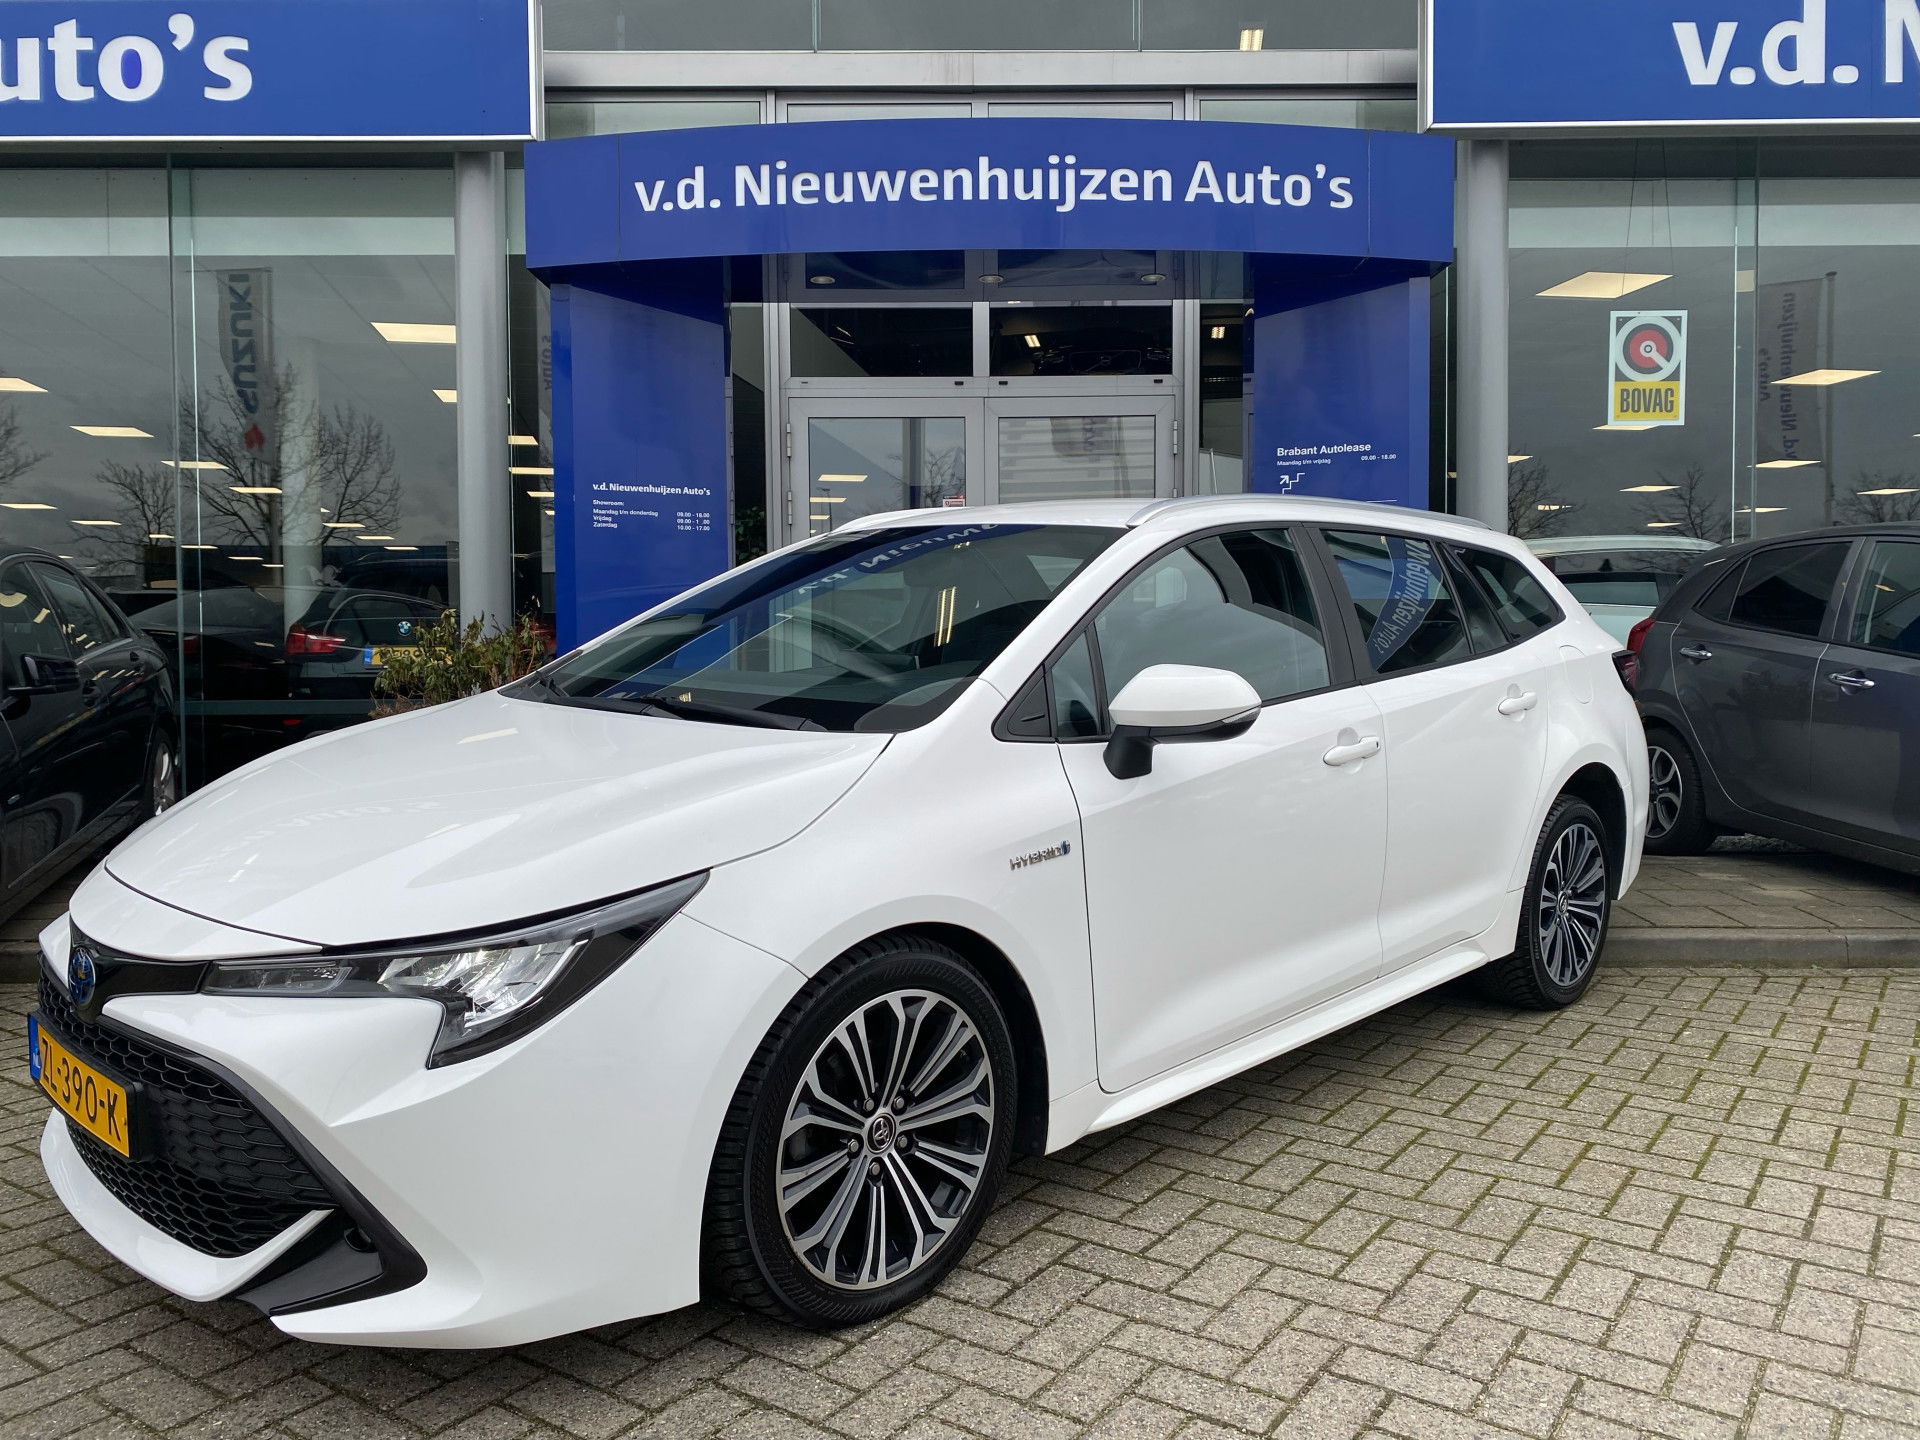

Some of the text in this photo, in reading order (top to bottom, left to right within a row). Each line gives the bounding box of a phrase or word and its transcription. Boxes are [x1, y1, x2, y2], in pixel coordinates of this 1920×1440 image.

[1672, 0, 1859, 85] v.d.
[634, 154, 1354, 213] v.d. Nieuwenhuijzen Auto's
[1620, 387, 1675, 413] BOVAG
[1277, 443, 1372, 457] Brabant Autolease
[592, 482, 711, 496] v.d. Nieuwenhuijzen Auto's
[593, 521, 618, 529] Zaterdag
[630, 509, 658, 517] donderdag
[1009, 846, 1062, 871] HYBRID
[41, 1037, 121, 1142] ZL-390-K
